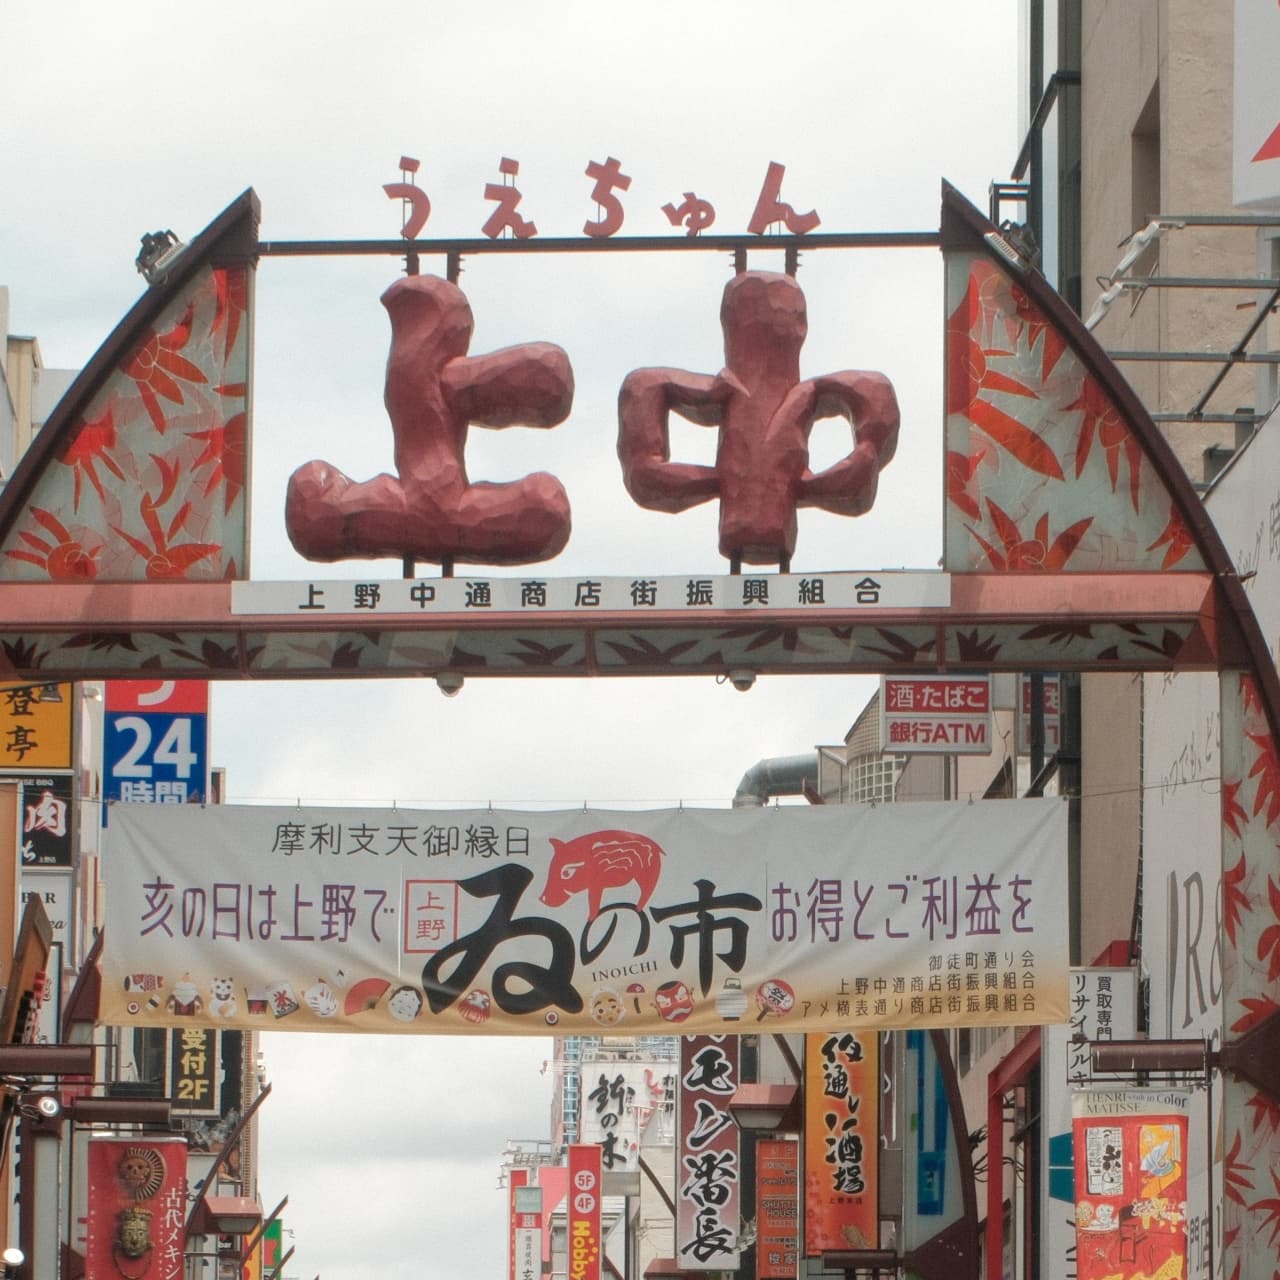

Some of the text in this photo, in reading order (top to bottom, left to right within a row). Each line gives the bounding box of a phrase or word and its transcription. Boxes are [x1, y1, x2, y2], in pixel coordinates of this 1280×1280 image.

[382, 156, 821, 239] うえちゅん
[285, 270, 901, 566] 上中
[299, 578, 883, 613] 上野中通商店街振興組合
[112, 716, 198, 779] 24
[889, 722, 985, 744] 銀行ATM
[271, 822, 531, 858] 摩利支天御縁日
[139, 875, 397, 943] 亥の日は上野で
[415, 890, 446, 942] 上野
[771, 872, 1035, 944] お得とご利益を
[592, 960, 659, 984] INOICHI
[928, 949, 1036, 971] 御徒町通り会
[836, 971, 1036, 996] 上野中通商店街振興組合
[681, 1035, 737, 1263] モン番長
[577, 1174, 592, 1188] 5F
[577, 1196, 592, 1210] 4F
[573, 1220, 598, 1280] Hobby
